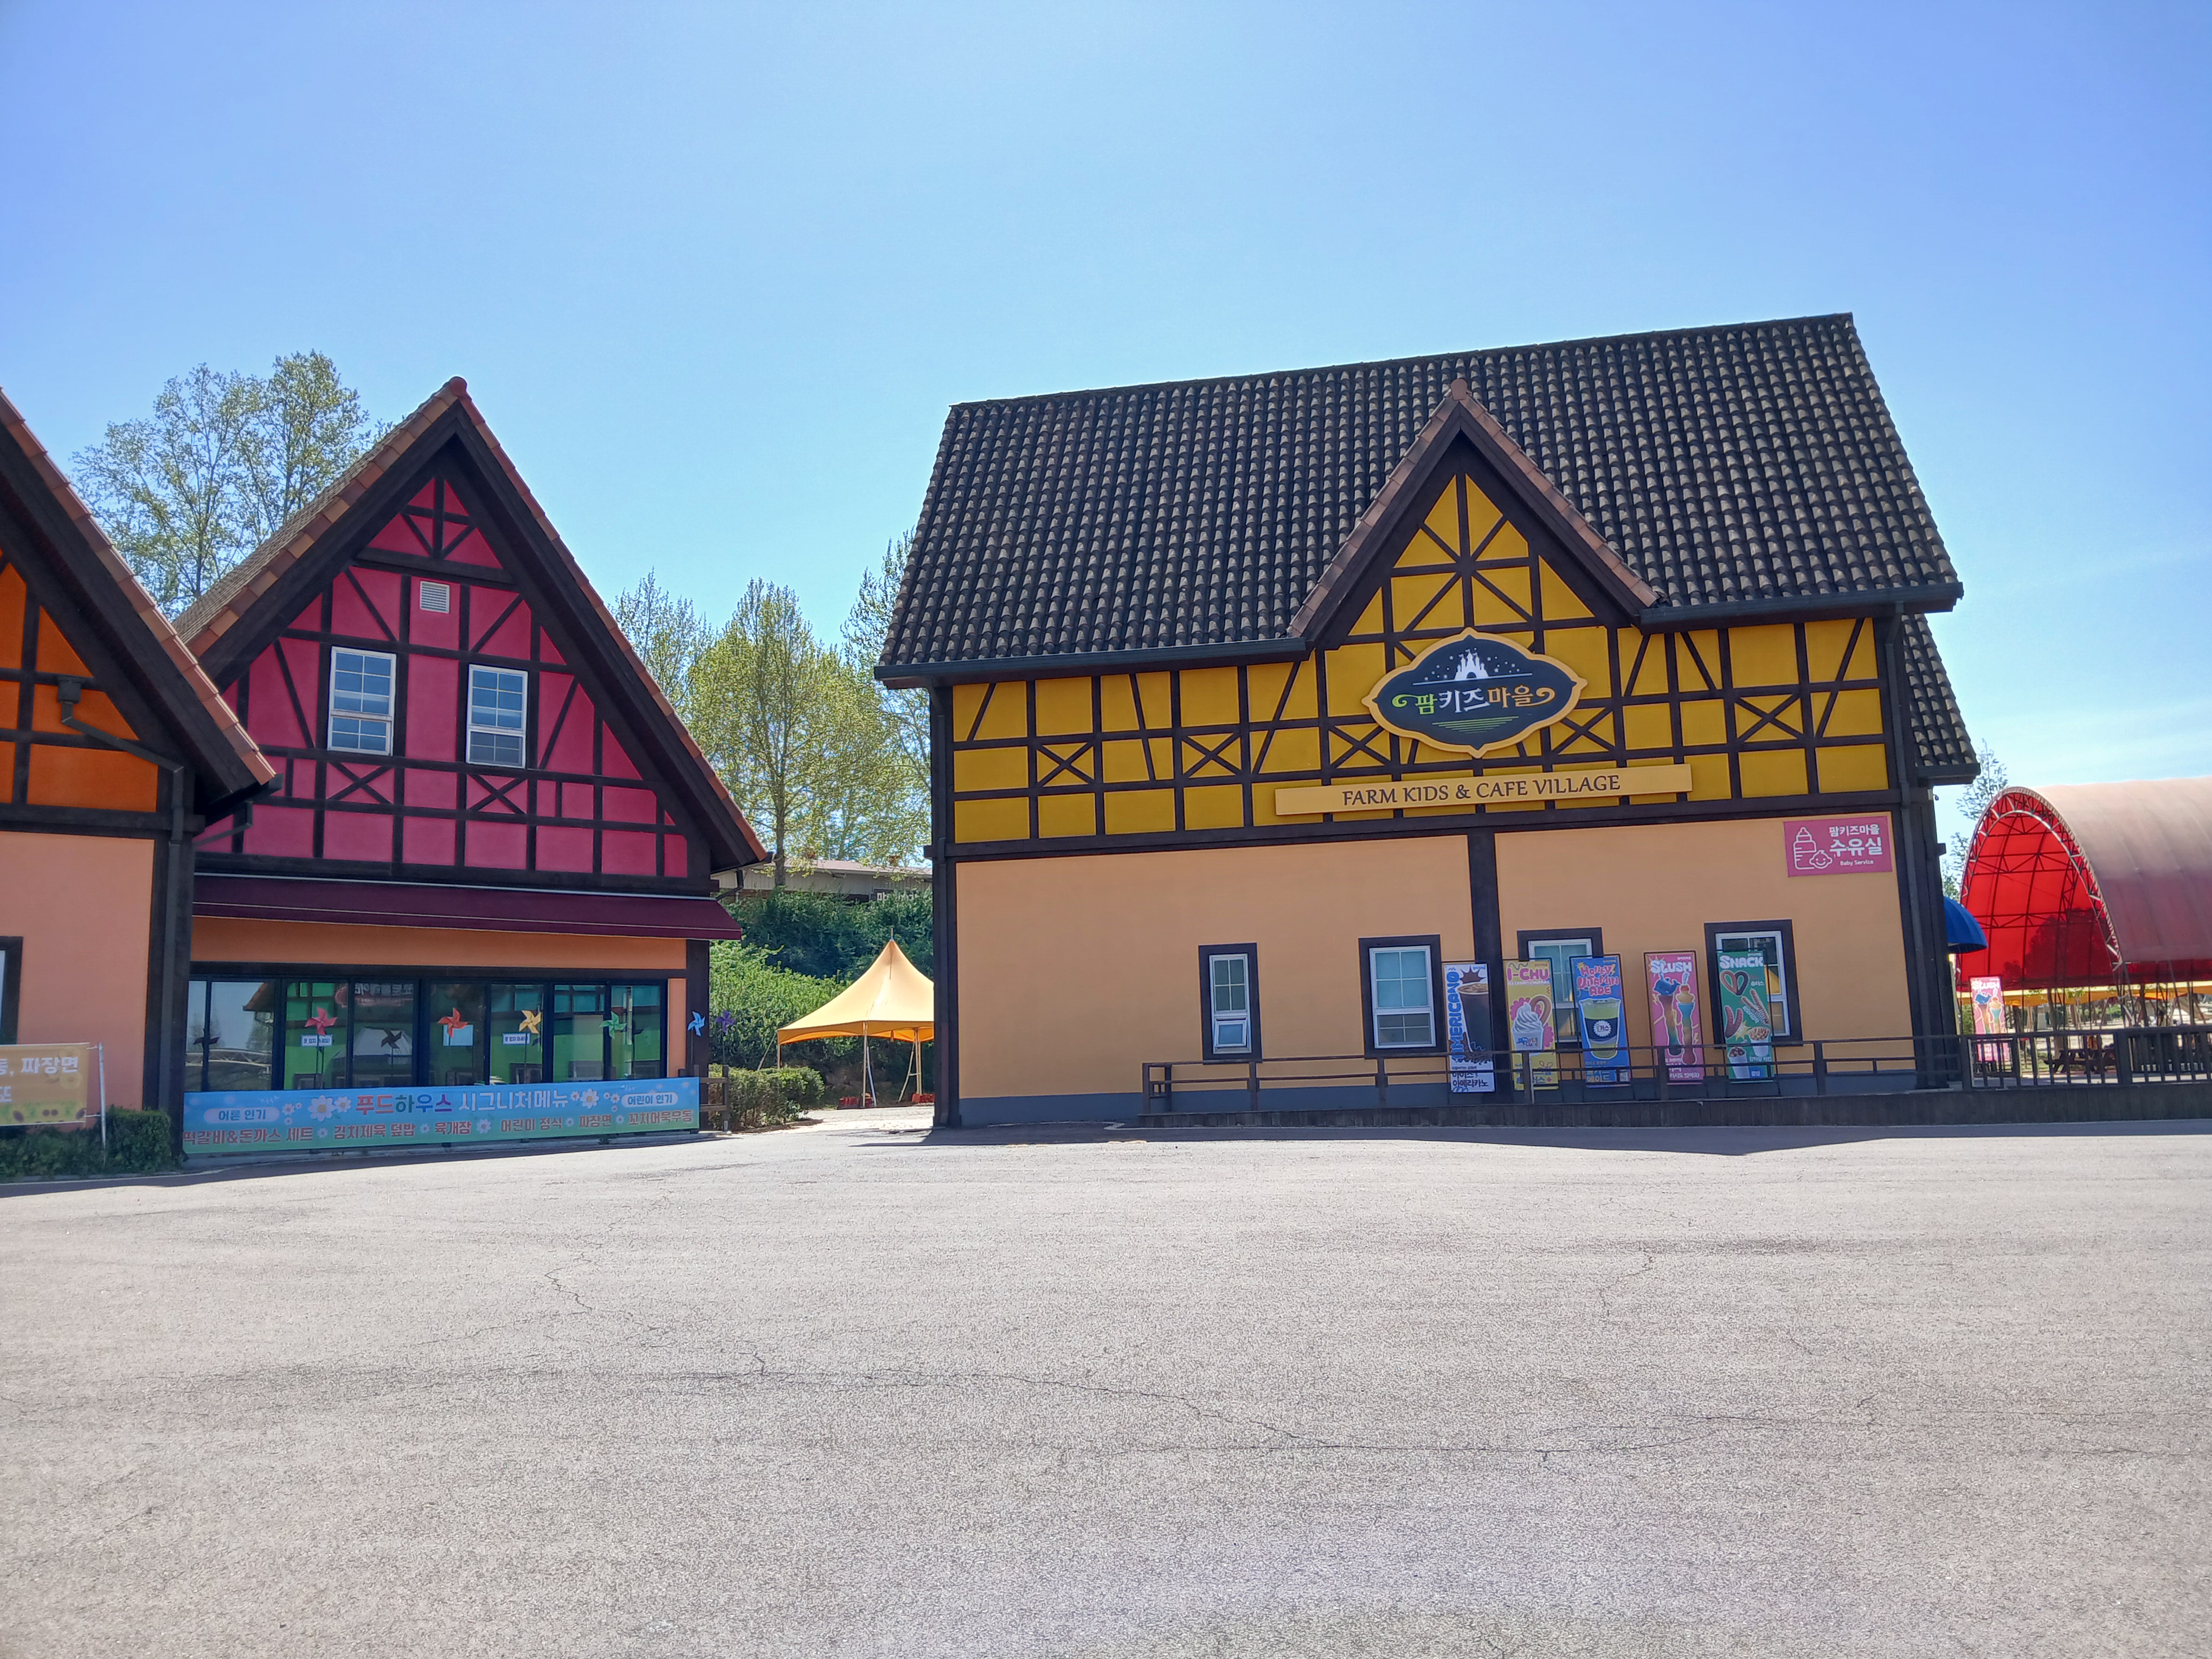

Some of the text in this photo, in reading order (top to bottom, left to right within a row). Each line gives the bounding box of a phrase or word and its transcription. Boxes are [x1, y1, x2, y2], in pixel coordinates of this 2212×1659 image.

[1411, 685, 1535, 716] 팜키즈마을
[1342, 774, 1621, 806] FARM KIDS & CAFE VILLAGE
[1829, 824, 1880, 837] 팜키즈마을
[1829, 837, 1883, 857] 수유실
[1651, 959, 1693, 974] SLUSH
[1719, 955, 1764, 969] SNACK
[1507, 968, 1550, 981] I-CHU
[1580, 965, 1613, 976] HONEY
[1577, 975, 1619, 989] VITAMIN
[1589, 985, 1612, 996] ADE
[21, 1057, 79, 1074] 짜장면
[1452, 1079, 1489, 1088] 아메리카노
[355, 1089, 569, 1115] 푸드하우스 시그니처메뉴
[628, 1094, 673, 1105] 어린이 인기
[218, 1109, 266, 1121] 어른 인기
[578, 1114, 612, 1128] 짜장면
[628, 1109, 692, 1126] 꼬치어묵우동
[333, 1123, 416, 1140] 김치제육 덮밥
[434, 1121, 472, 1135] 육개장
[500, 1117, 563, 1133] 어린이 정식
[286, 1127, 314, 1142] 세트
